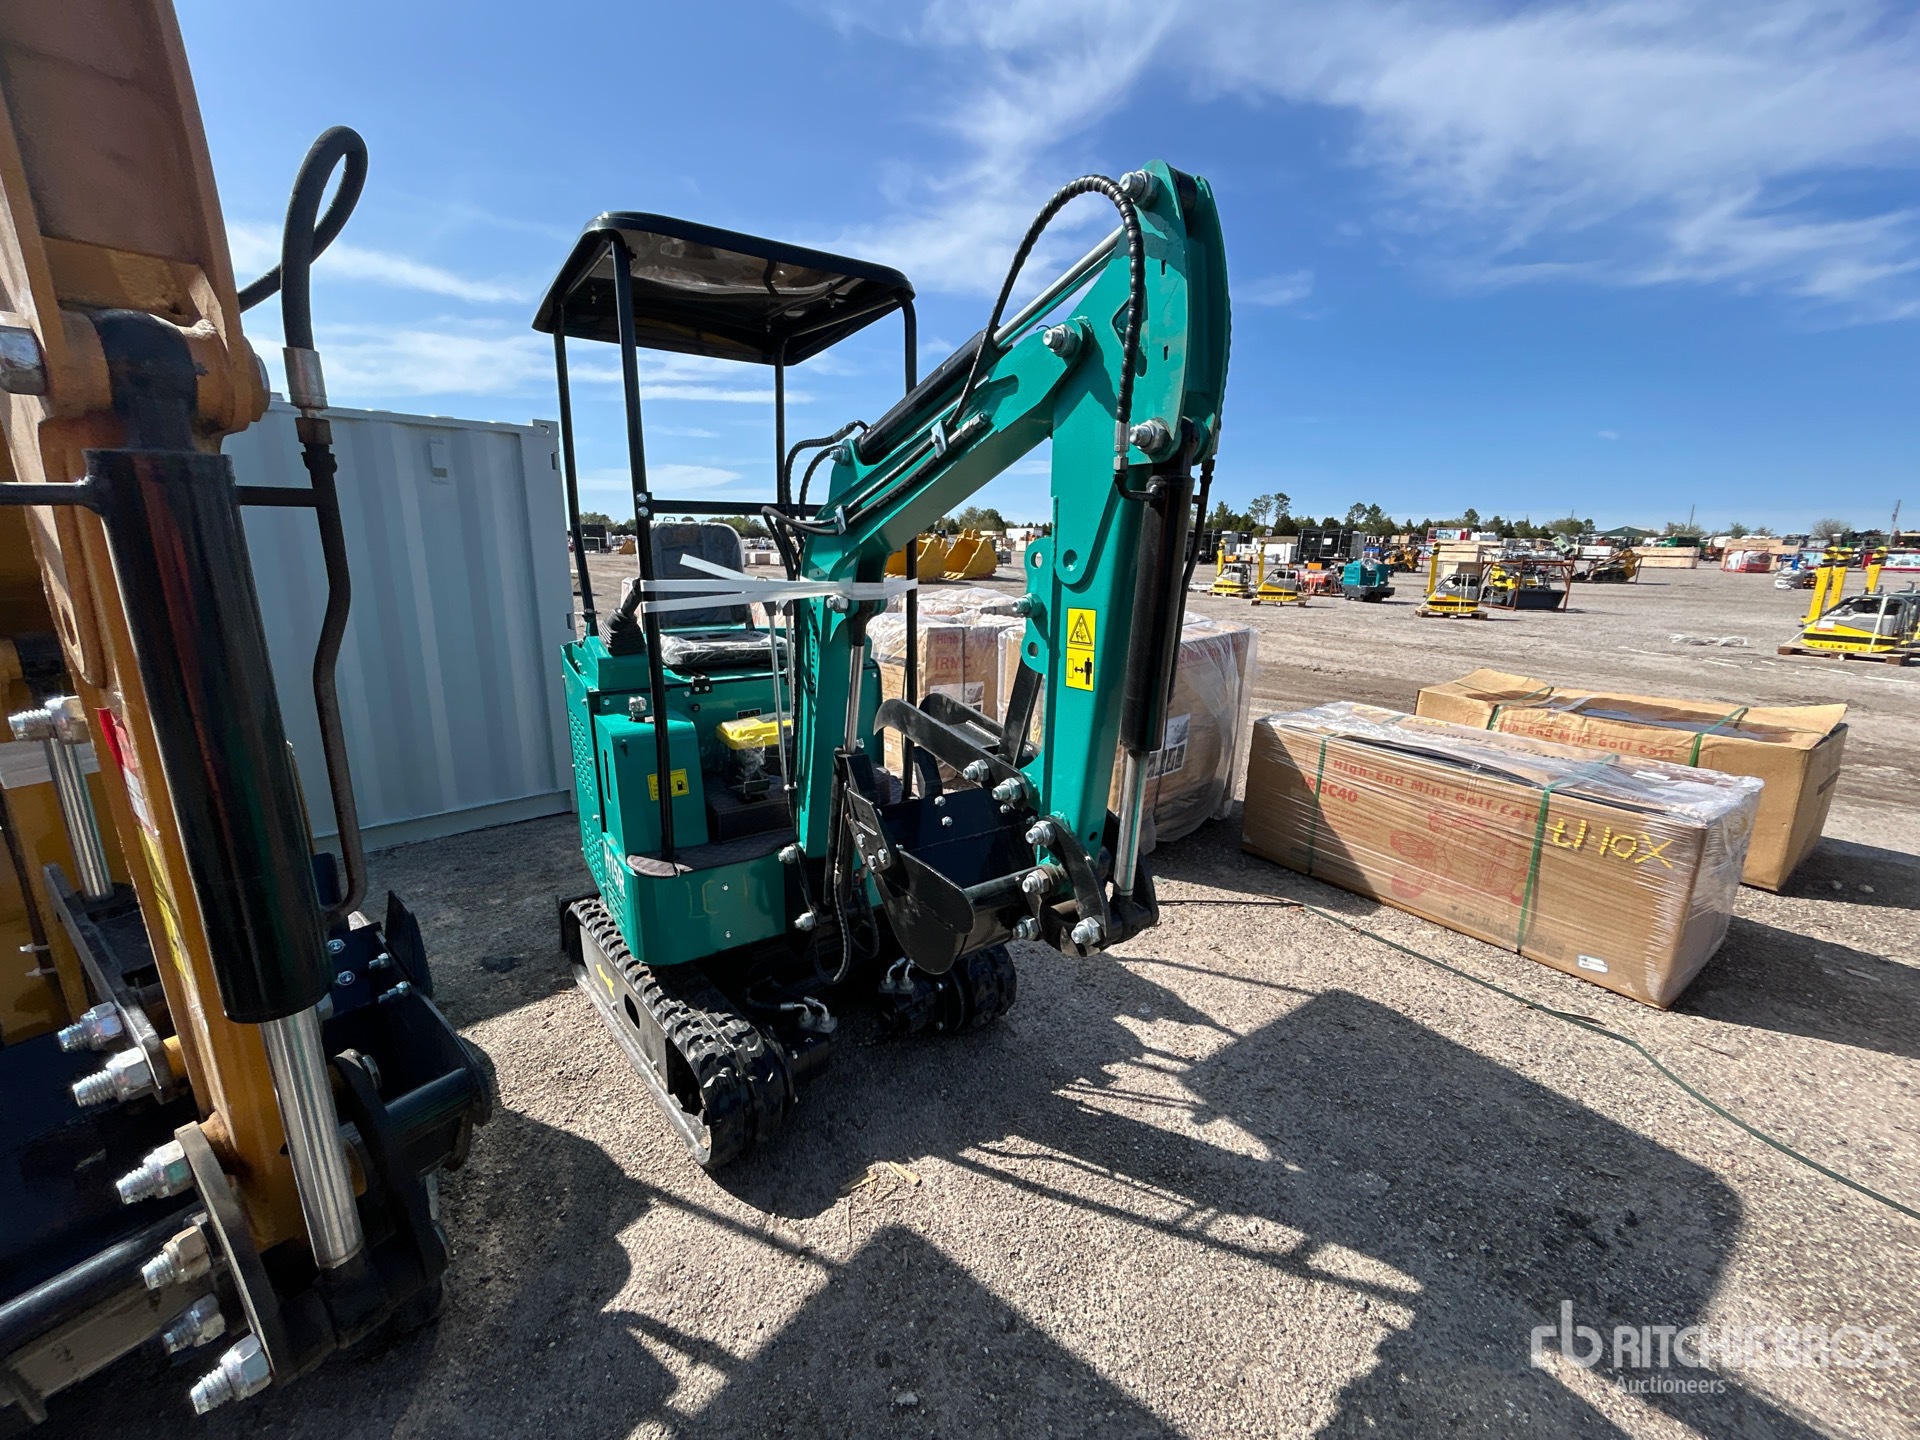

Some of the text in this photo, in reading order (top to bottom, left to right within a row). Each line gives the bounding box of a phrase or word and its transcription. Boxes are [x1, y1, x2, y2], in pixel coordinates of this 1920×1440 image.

[1598, 738, 1631, 751] Golf
[1638, 744, 1675, 758] Cart
[1410, 780, 1448, 799] Mini
[1455, 792, 1492, 811] Golf
